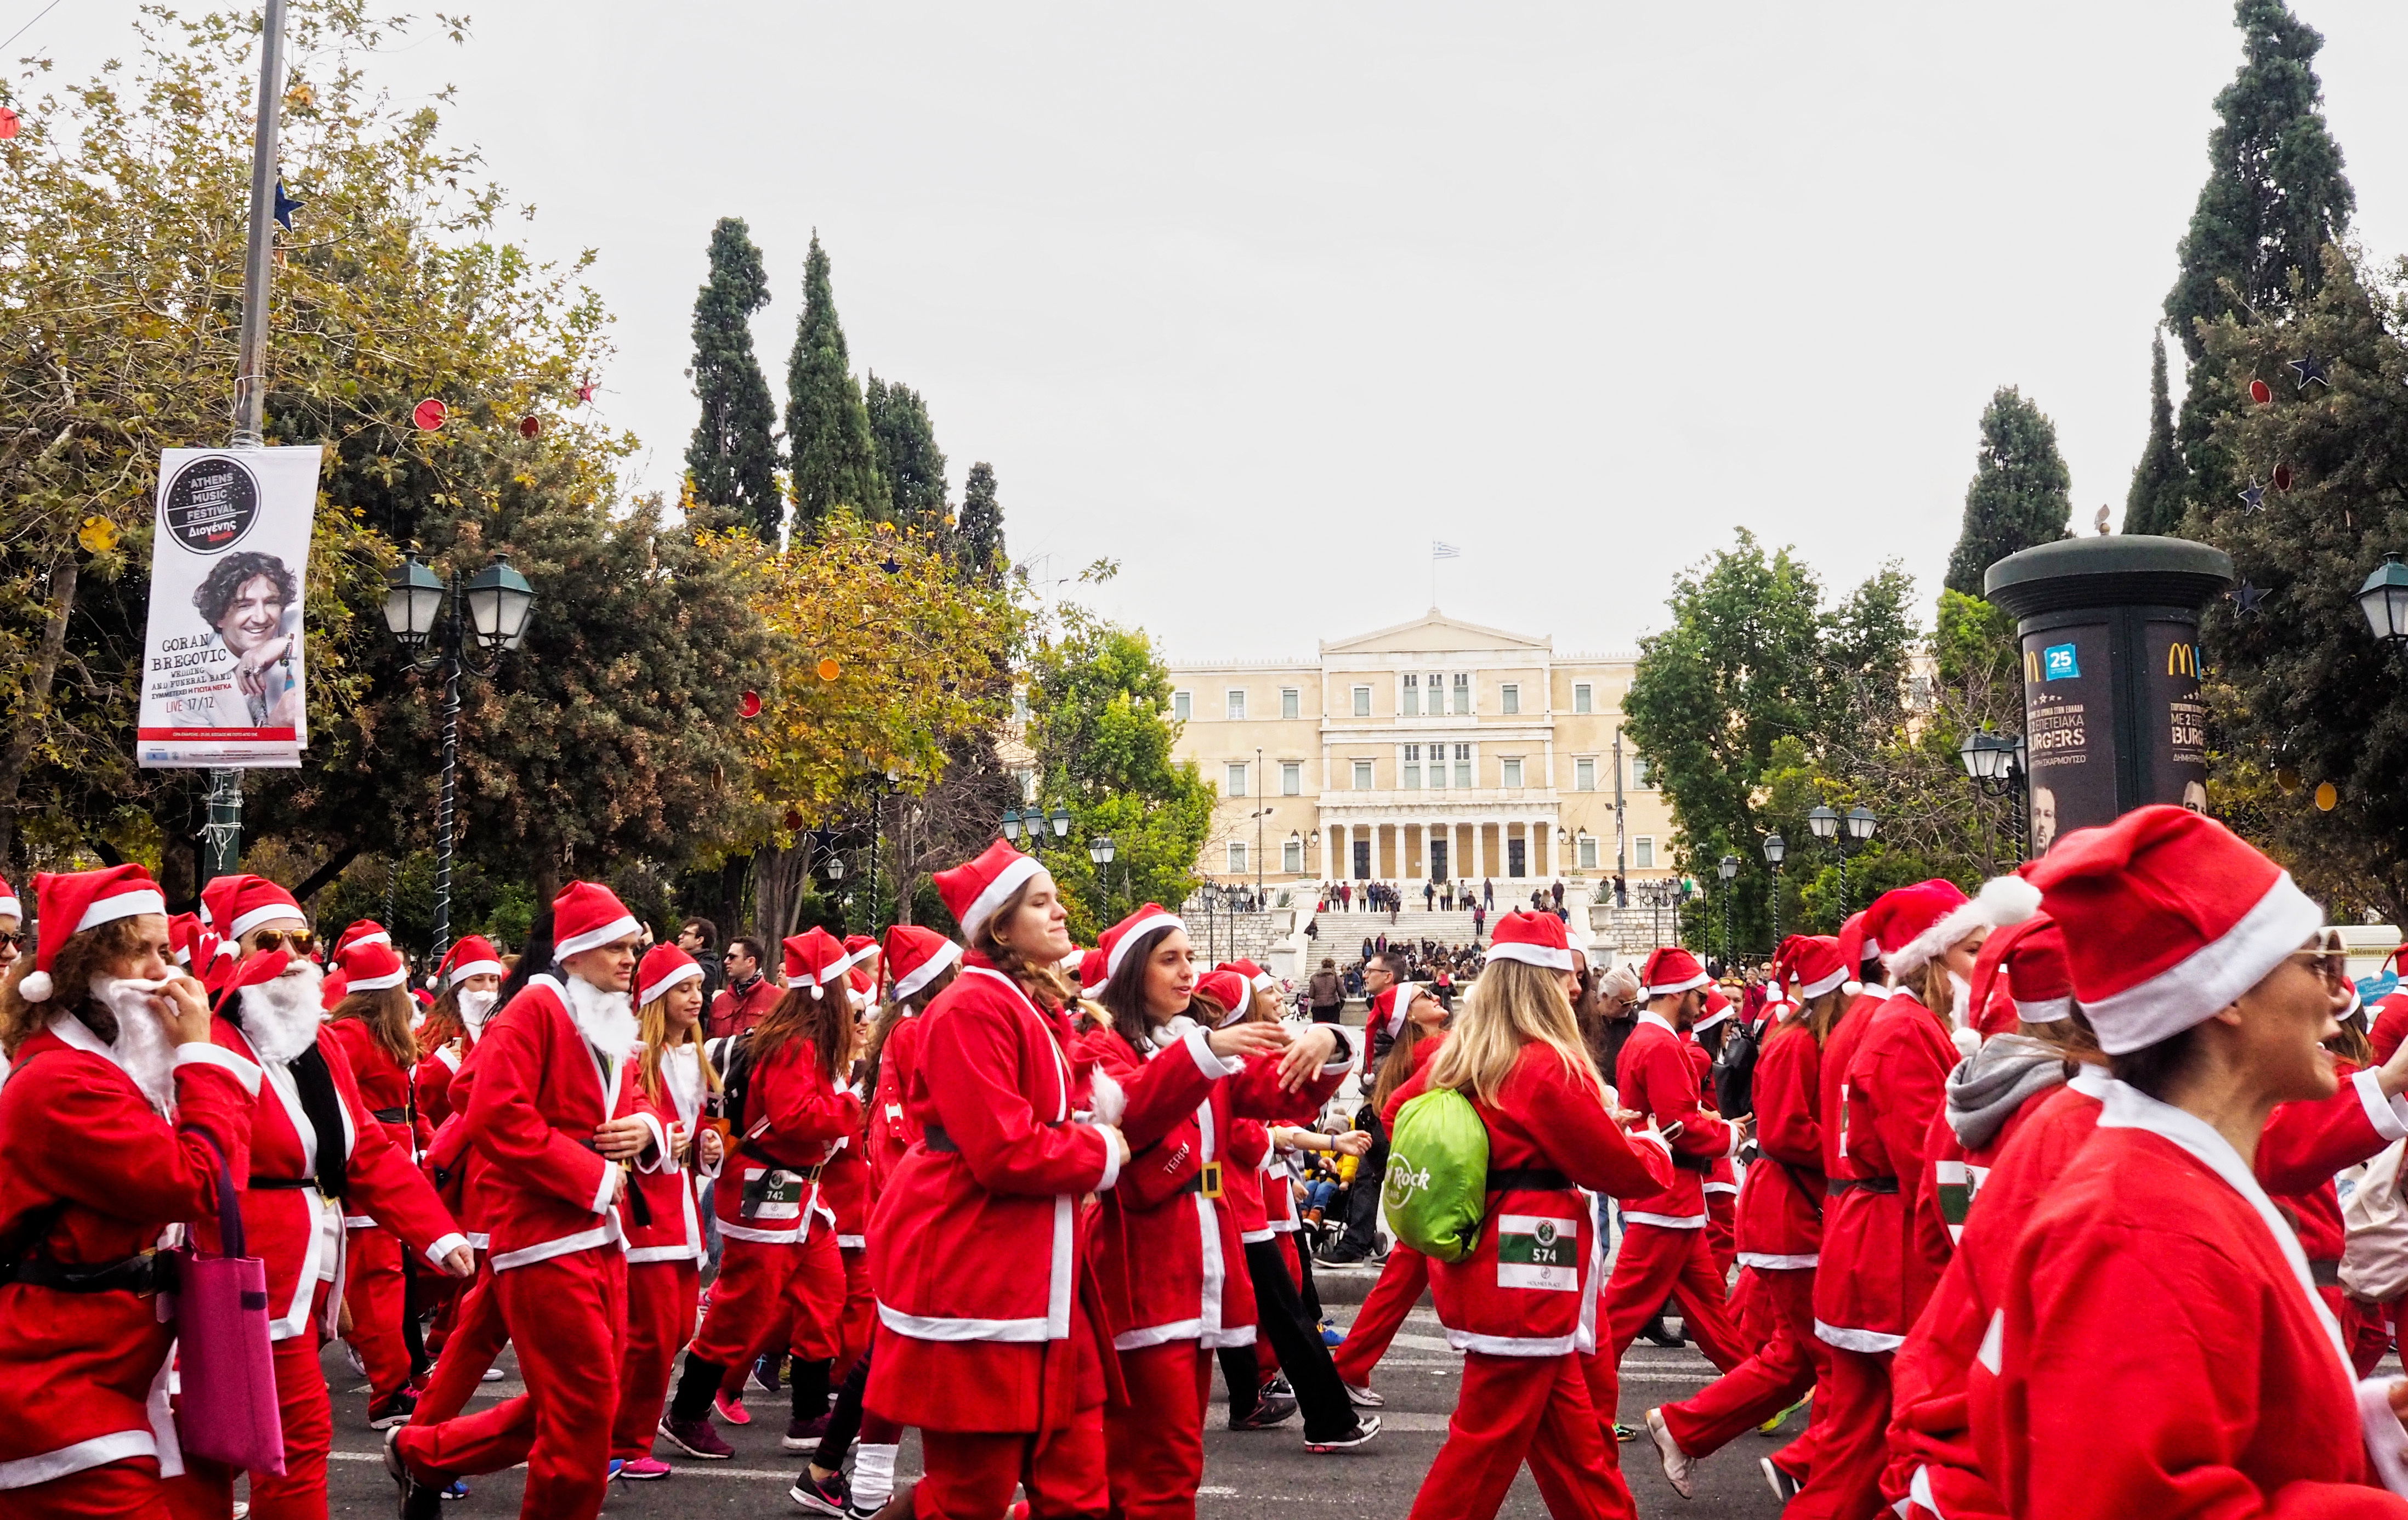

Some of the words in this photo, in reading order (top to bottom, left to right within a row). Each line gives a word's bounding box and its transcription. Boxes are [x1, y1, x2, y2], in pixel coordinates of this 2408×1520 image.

[190, 473, 234, 489] ATHENS
[192, 489, 228, 503] MUSIC
[186, 503, 236, 520] FESTIVAL
[188, 520, 237, 538] Διογένης
[162, 633, 209, 652] GORAN
[151, 649, 226, 671] BREGOVIC
[2050, 651, 2071, 668] 25
[171, 667, 205, 678] WEDDING
[151, 682, 168, 690] AND
[170, 676, 207, 688] FUNERAL
[209, 673, 232, 682] BAND
[166, 700, 183, 713] LIVE
[188, 696, 214, 711] 17/12
[2036, 714, 2085, 731] ΕΠΕΤΕΙΑΚΑ
[2185, 714, 2191, 725] 2
[2172, 727, 2203, 746] BURG
[1163, 1140, 1189, 1173] TERRA
[1393, 1166, 1430, 1190] Rock
[766, 1190, 784, 1201] 742
[1532, 1247, 1557, 1264] 574
